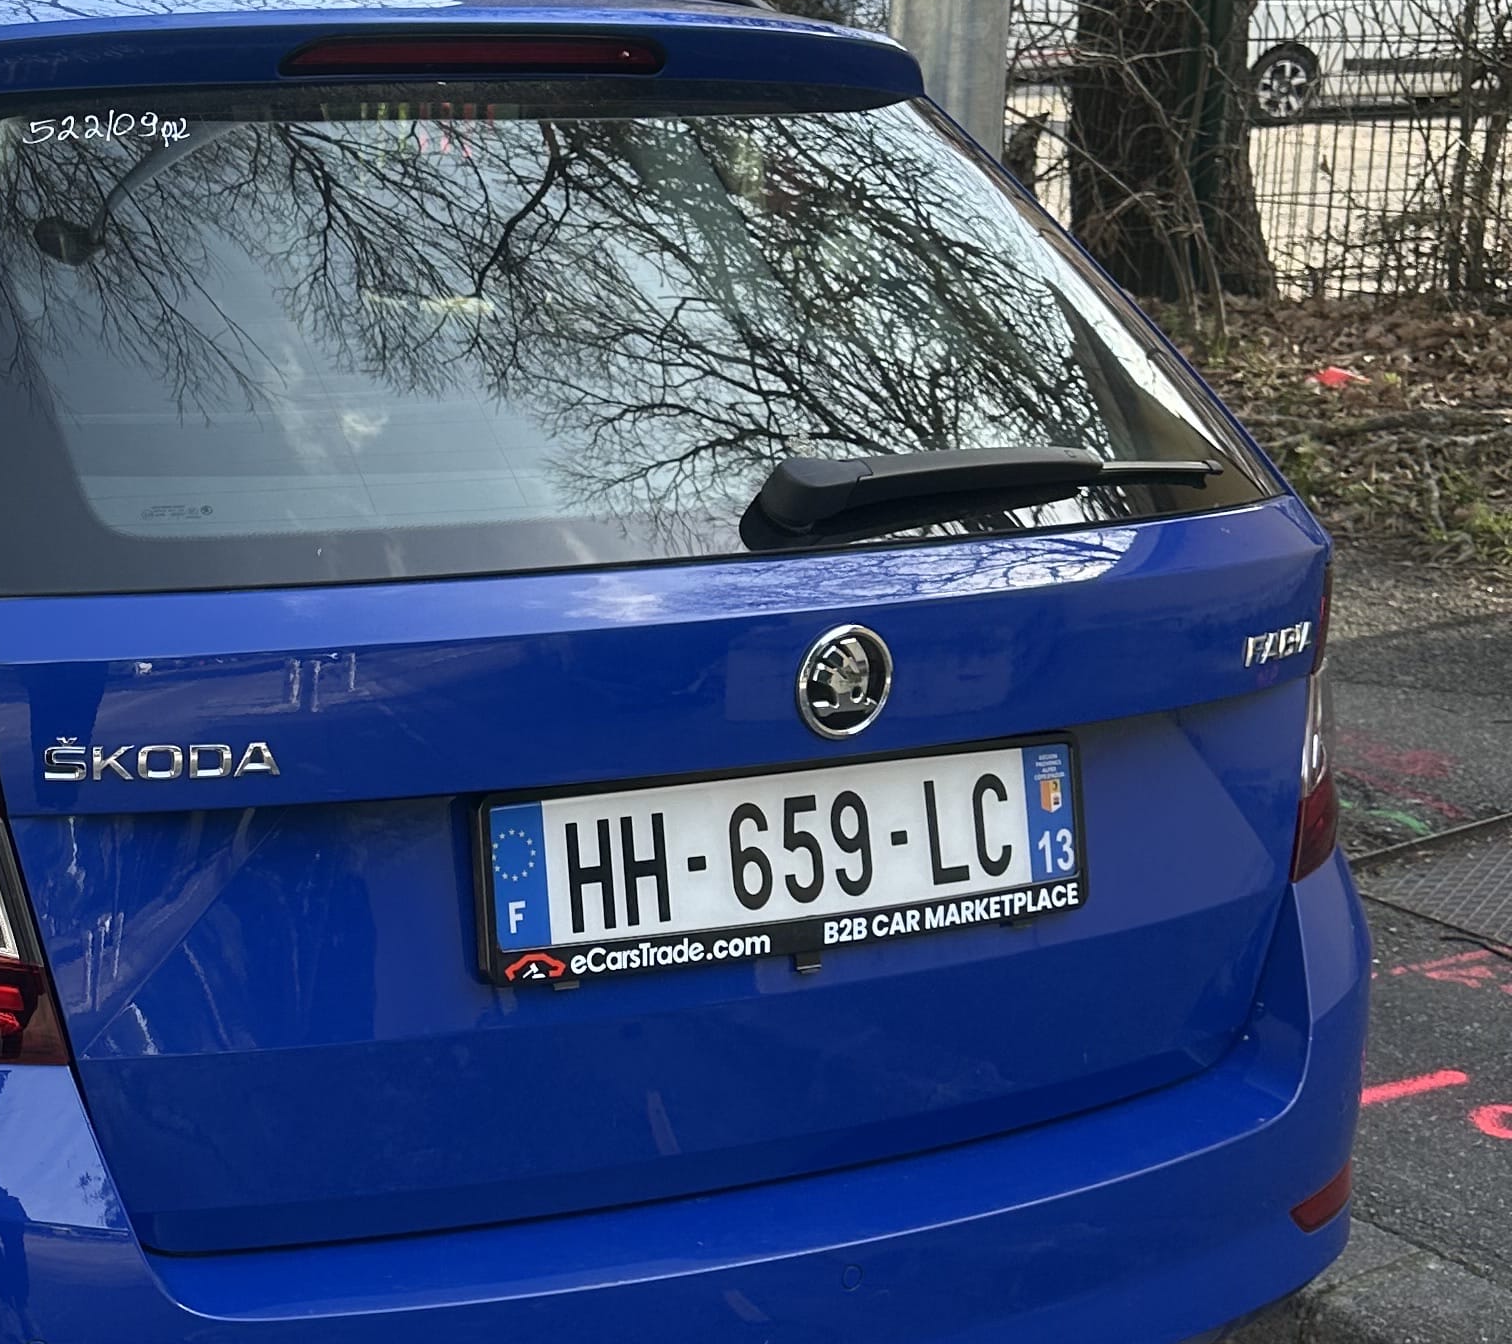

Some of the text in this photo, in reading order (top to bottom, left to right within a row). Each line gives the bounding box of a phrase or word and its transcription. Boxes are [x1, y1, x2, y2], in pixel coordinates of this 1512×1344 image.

[44, 736, 281, 782] ŠKODA
[564, 773, 1013, 934] HH-659-LC
[1038, 828, 1075, 874] 13
[508, 900, 526, 934] F
[823, 882, 1080, 945] B2B CAR MARKETPLACE
[570, 934, 771, 975] eCarsTrade.com
